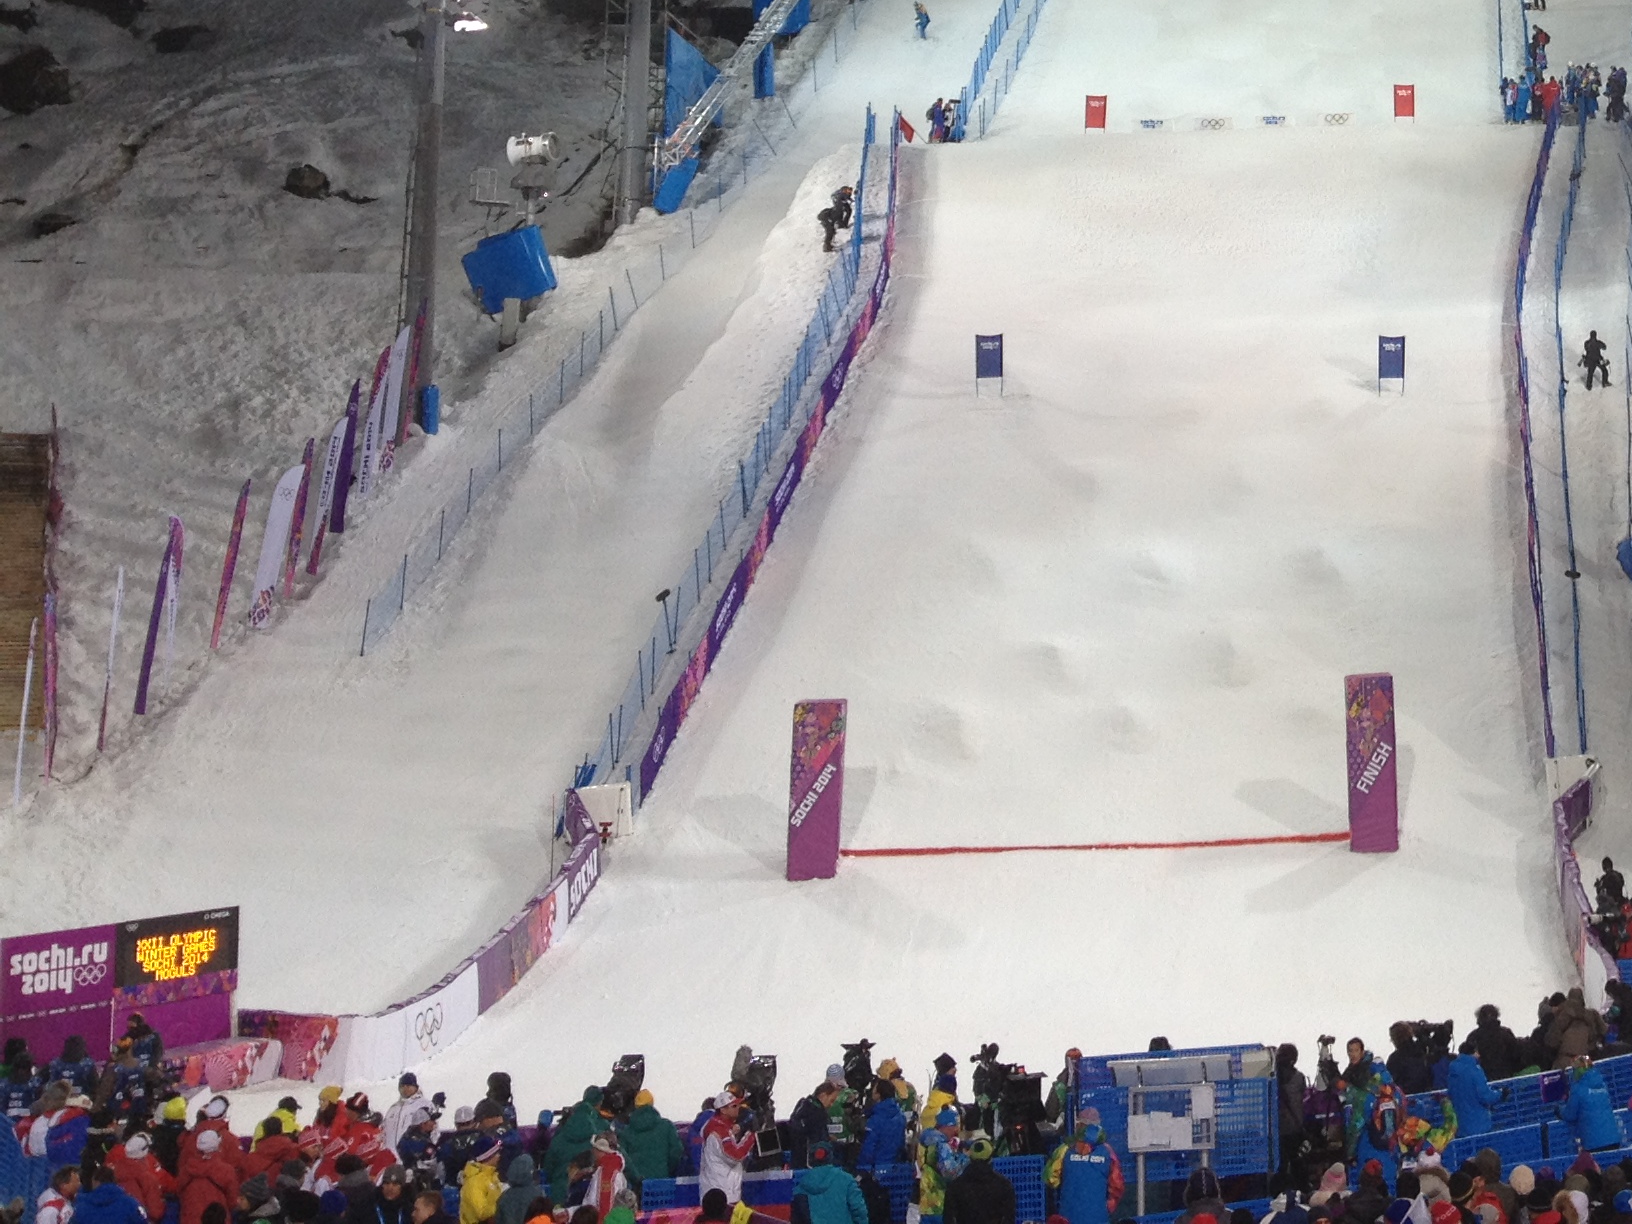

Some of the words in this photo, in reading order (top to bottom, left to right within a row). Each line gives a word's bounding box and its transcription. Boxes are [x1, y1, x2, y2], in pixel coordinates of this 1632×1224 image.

[1356, 741, 1393, 794] FINISH
[790, 790, 819, 828] SOCHI
[812, 763, 837, 793] 2014
[570, 848, 598, 916] SOCHI
[136, 936, 163, 950] XXII
[170, 929, 217, 946] OLYMPIC
[136, 946, 177, 963] WINTER
[182, 940, 215, 954] GAMES
[10, 942, 108, 976] sochi.ru
[143, 957, 175, 973] SOCHI
[182, 952, 209, 966] 2014
[155, 964, 196, 981] MOGULS
[22, 968, 73, 995] 2014
